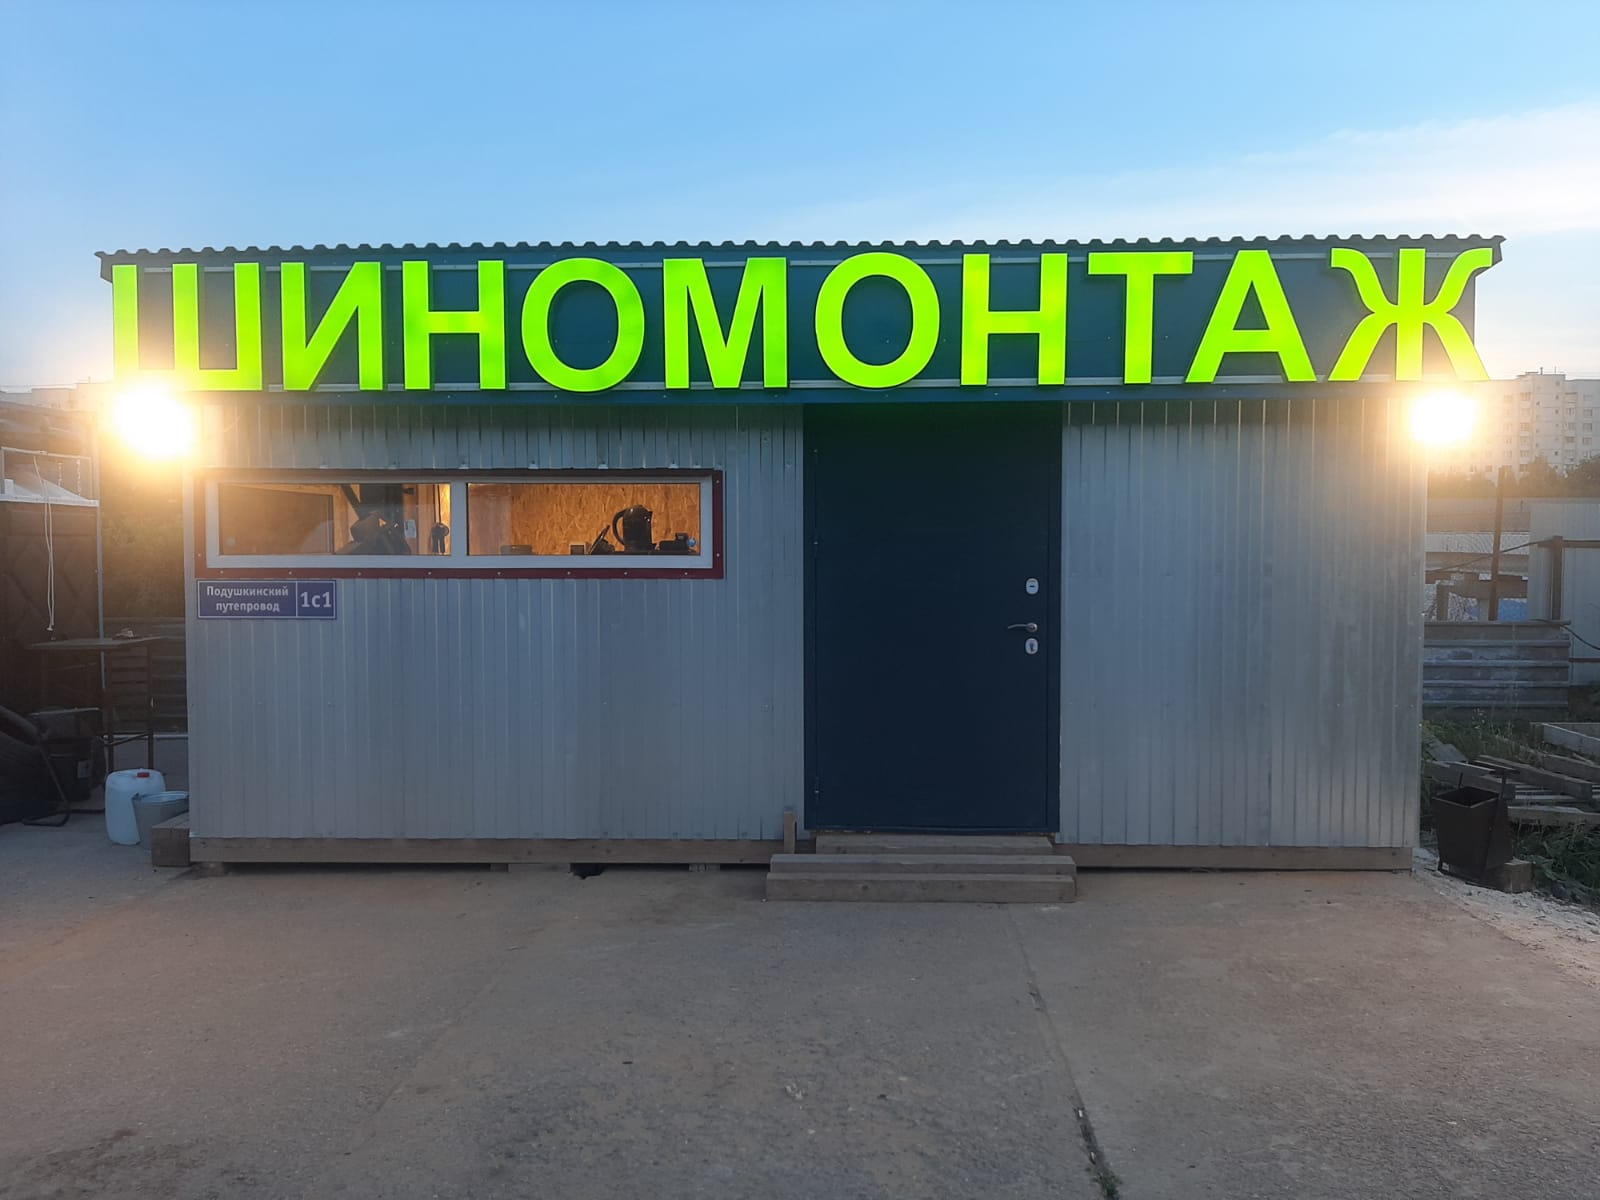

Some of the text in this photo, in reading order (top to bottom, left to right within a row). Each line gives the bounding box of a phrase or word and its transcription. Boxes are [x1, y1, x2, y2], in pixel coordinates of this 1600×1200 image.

[112, 247, 1492, 392] ШИНОМОНТАЖ
[206, 585, 289, 599] Подушкинский
[300, 591, 332, 608] 1с1
[215, 602, 280, 614] путепровод
